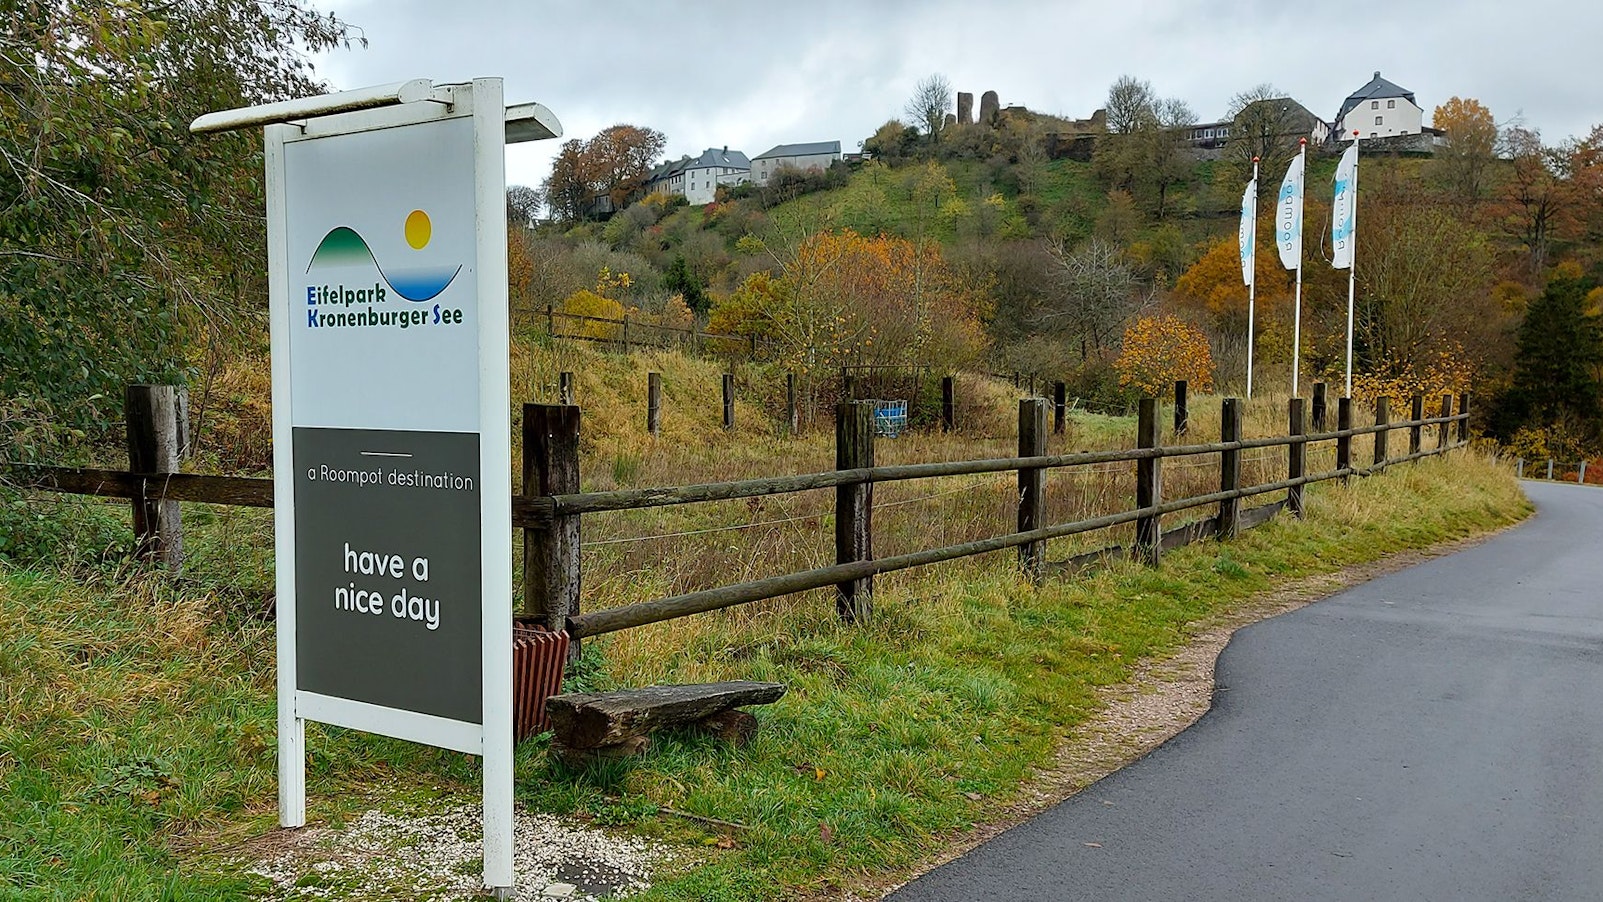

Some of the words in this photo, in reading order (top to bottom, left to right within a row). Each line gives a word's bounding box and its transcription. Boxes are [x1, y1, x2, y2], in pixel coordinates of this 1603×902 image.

[307, 283, 386, 307] Eifelpark
[307, 307, 428, 328] Kronenburger
[433, 304, 463, 325] See
[307, 467, 316, 481] a
[320, 464, 383, 487] Roompot
[388, 469, 473, 491] destination
[344, 542, 404, 579] have
[412, 556, 429, 582] a
[335, 582, 383, 615] nice
[391, 588, 440, 631] day
